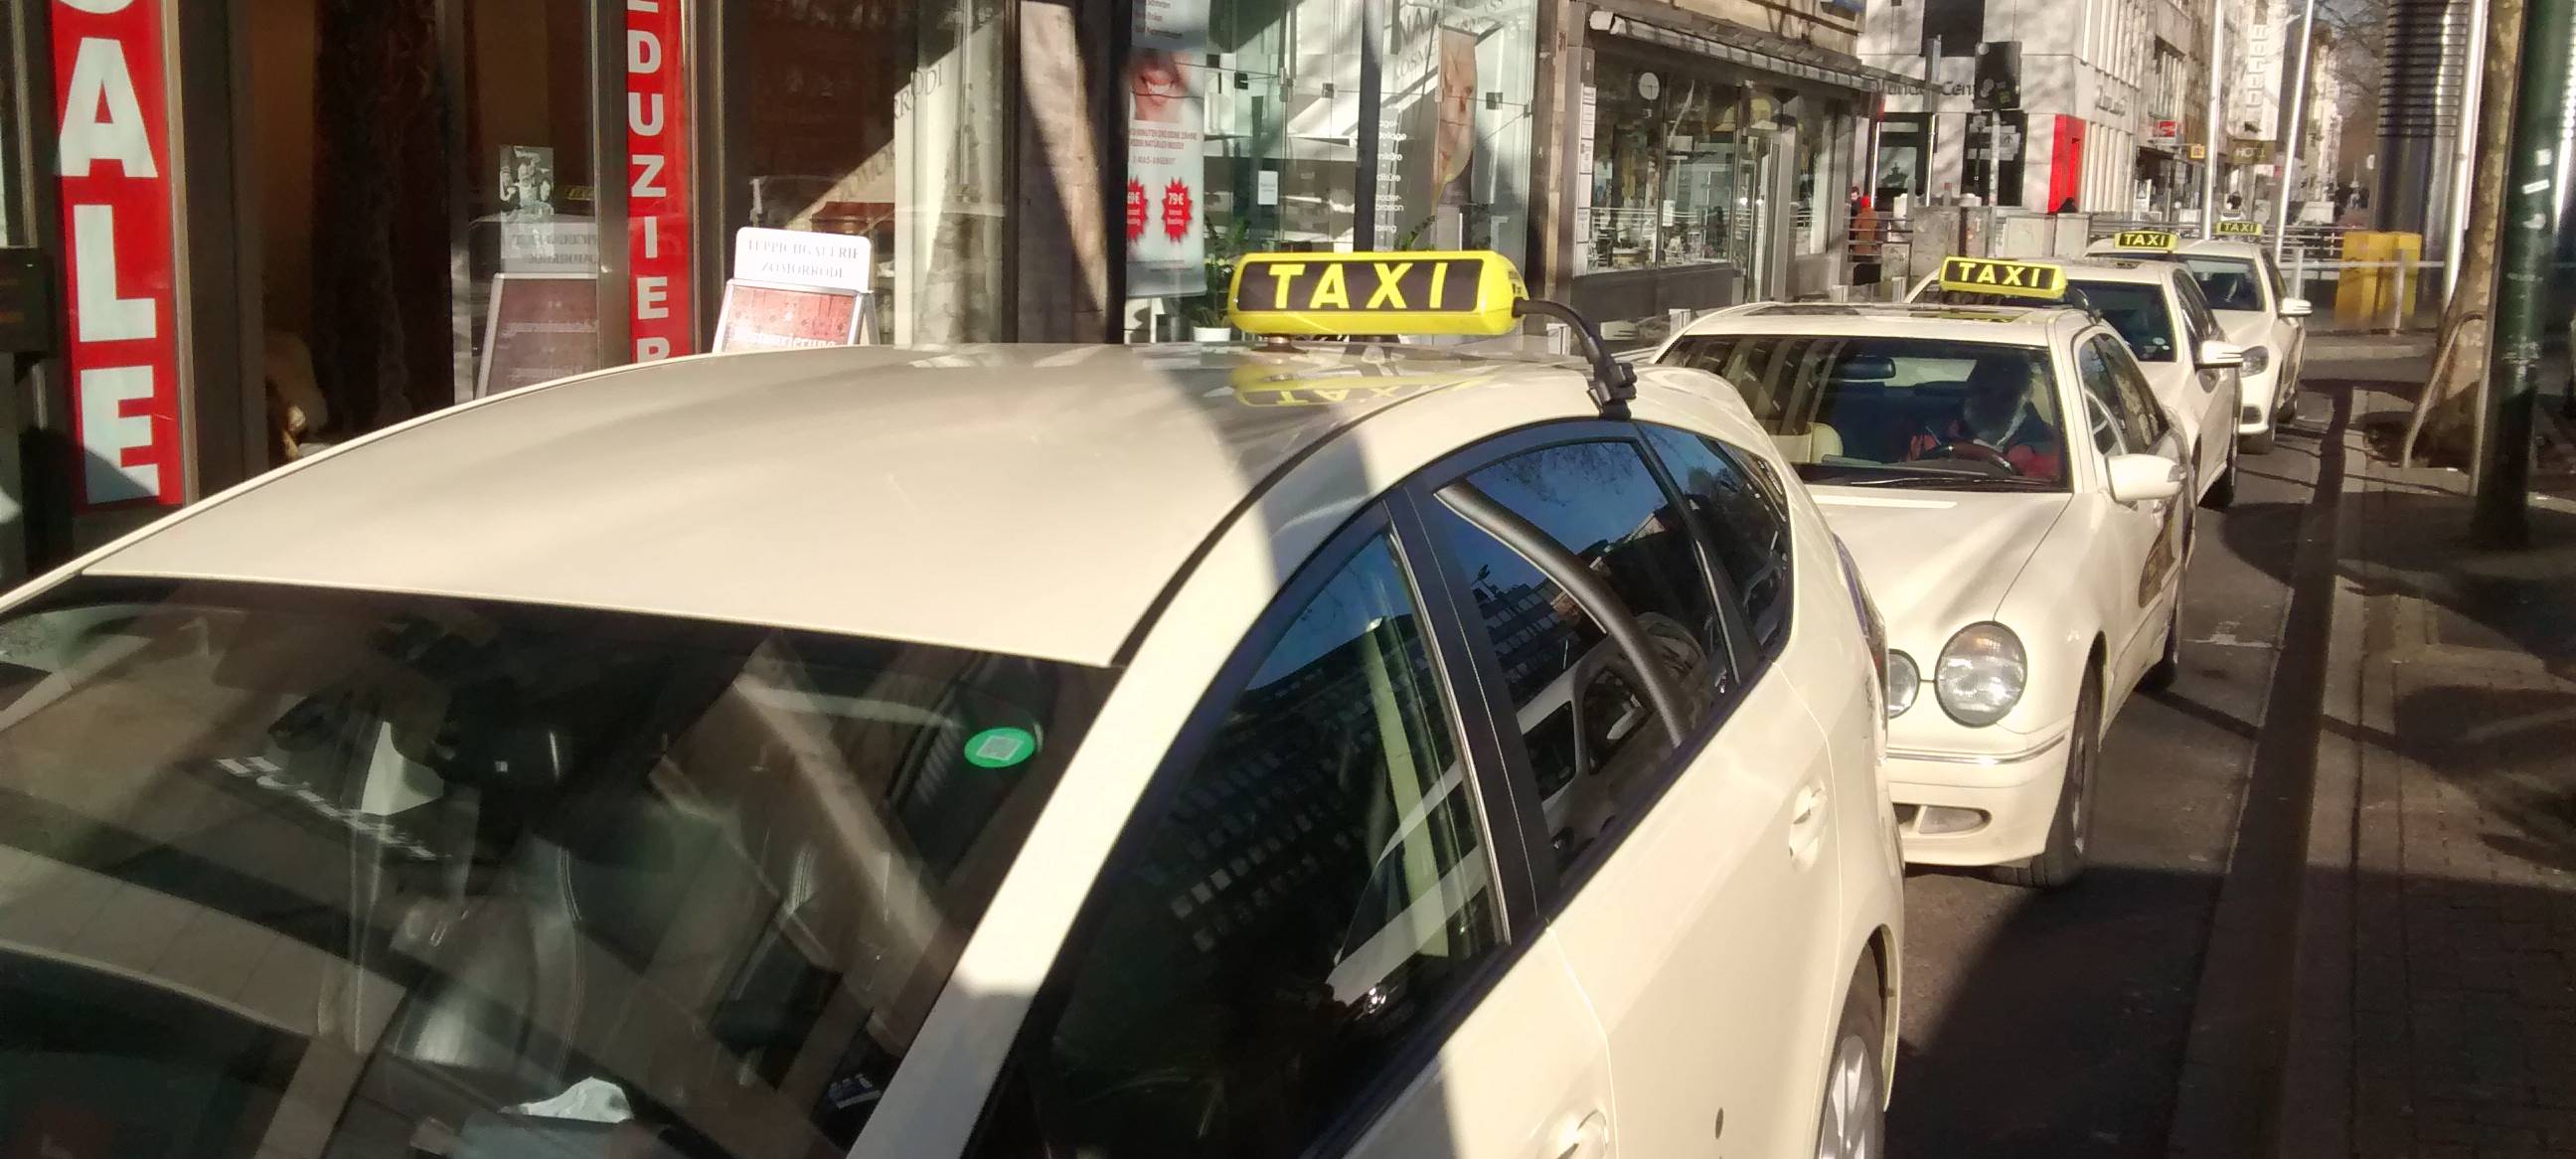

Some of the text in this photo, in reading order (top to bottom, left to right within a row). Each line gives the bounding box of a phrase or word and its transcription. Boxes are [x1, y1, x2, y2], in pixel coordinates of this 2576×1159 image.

[627, 0, 670, 362] DUZIER
[2124, 234, 2166, 247] TAXI
[2224, 223, 2254, 233] TAXI
[55, 0, 158, 504] ALE
[1268, 262, 1448, 309] TAXI
[1959, 261, 2040, 287] TAXI
